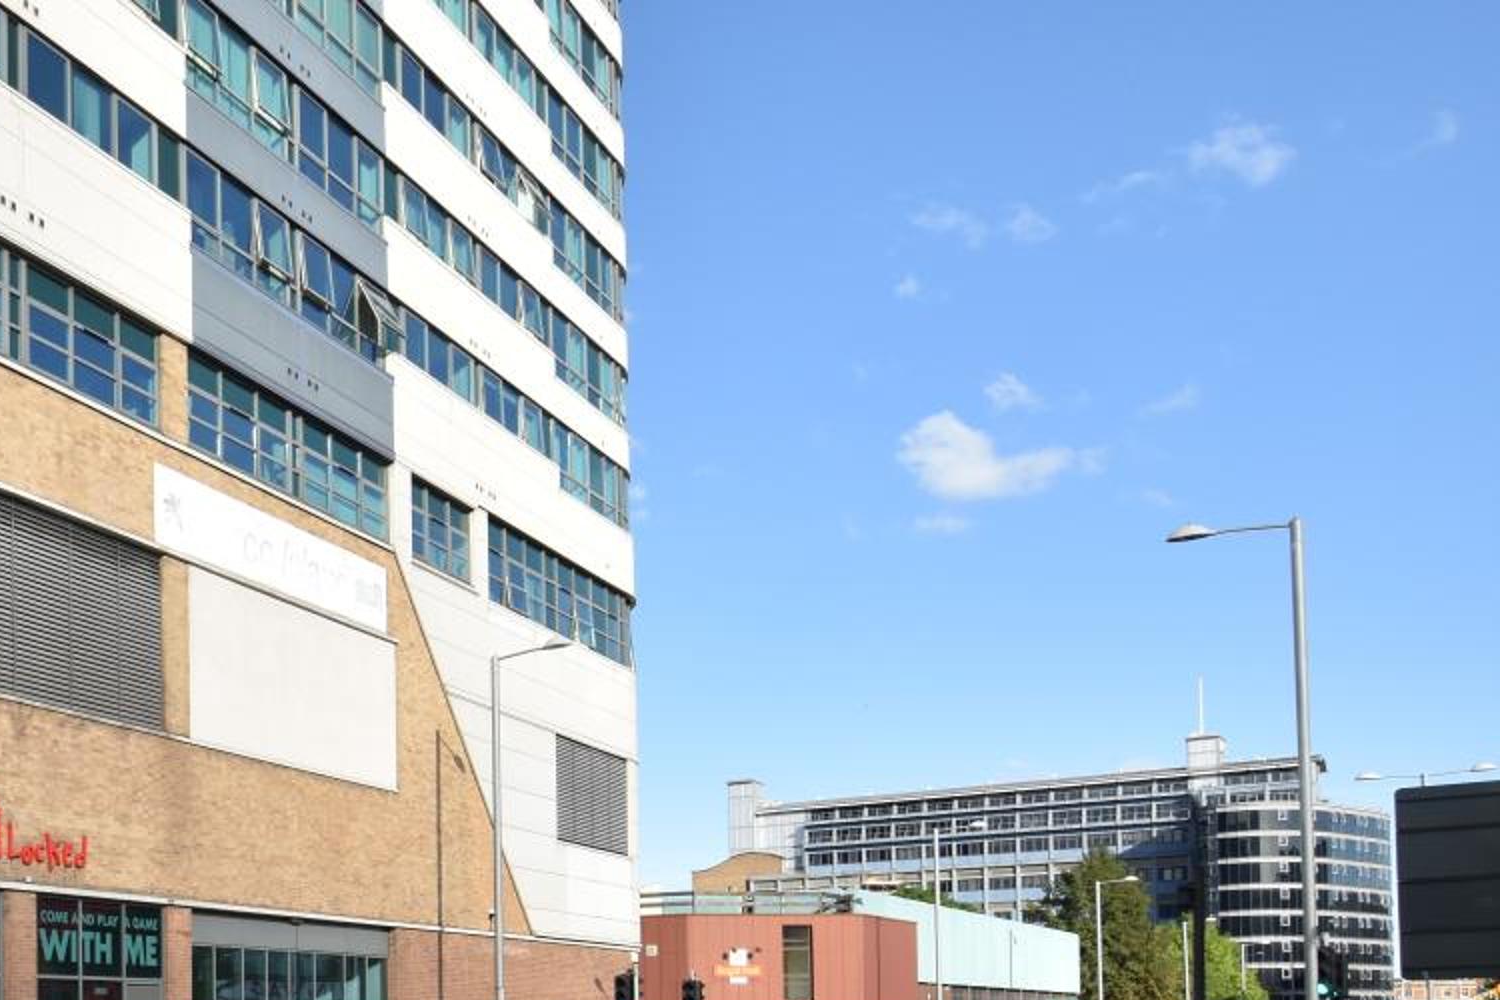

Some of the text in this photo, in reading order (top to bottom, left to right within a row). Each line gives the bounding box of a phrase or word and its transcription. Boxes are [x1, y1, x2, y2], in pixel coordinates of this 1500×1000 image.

[40, 910, 69, 924] COME
[71, 912, 95, 926] AND
[97, 914, 119, 927] PLAY
[132, 918, 159, 931] GAME
[39, 928, 158, 967] WITH ME
